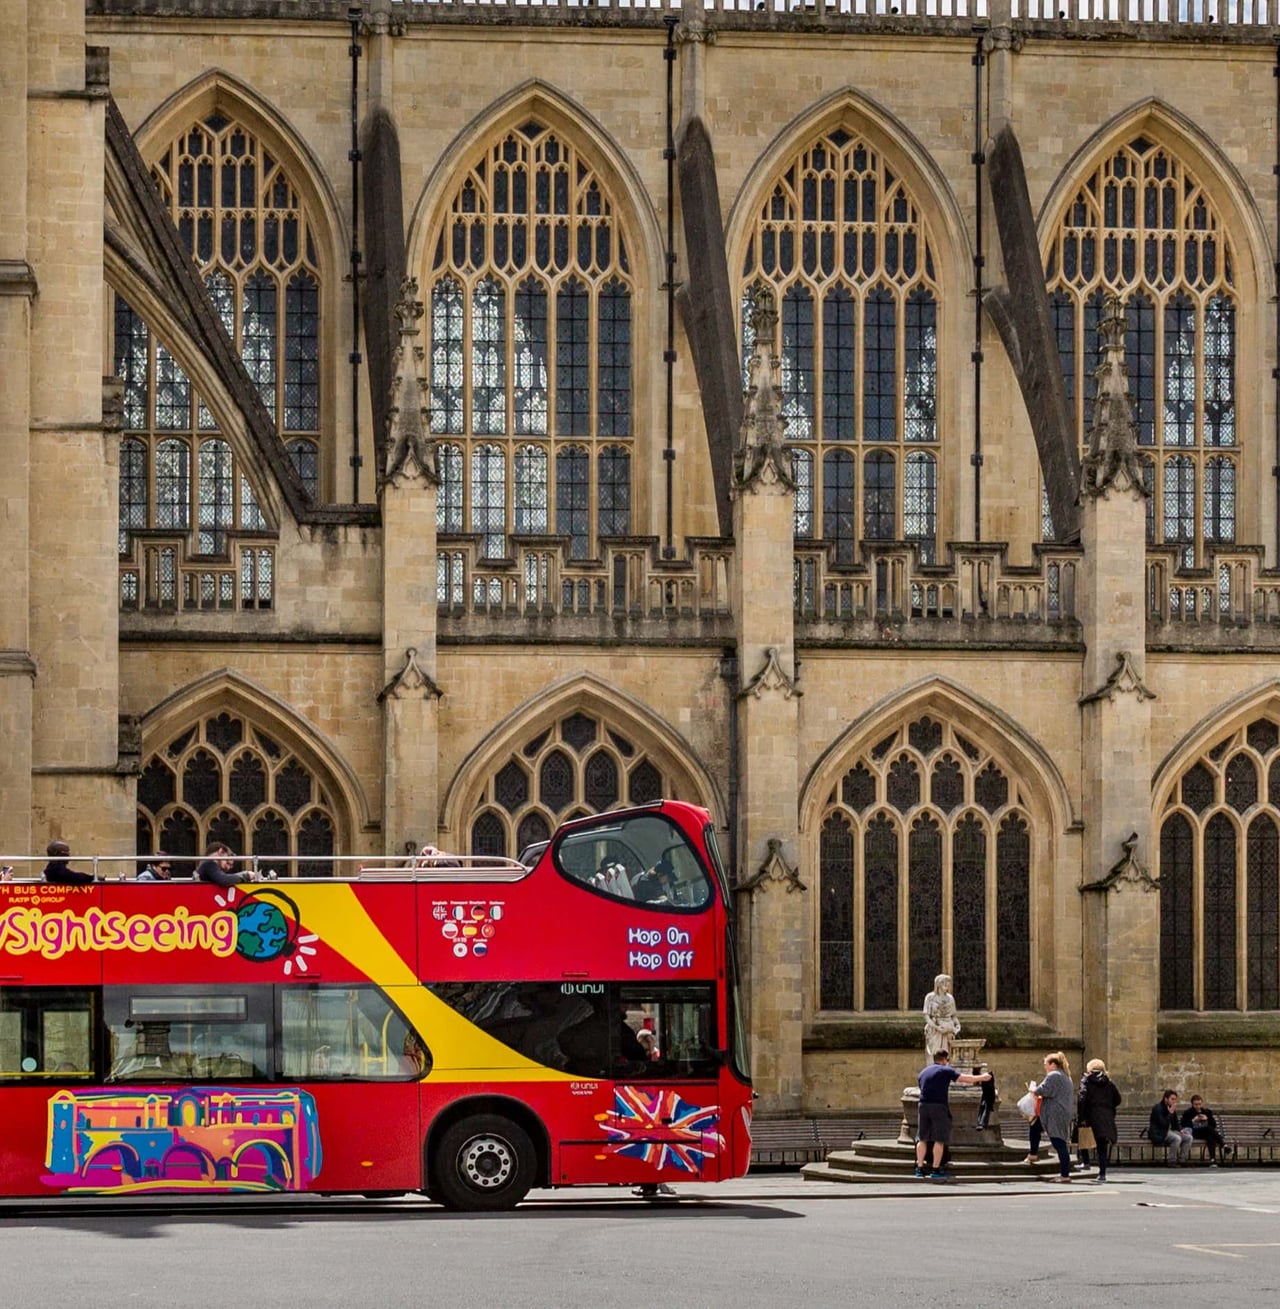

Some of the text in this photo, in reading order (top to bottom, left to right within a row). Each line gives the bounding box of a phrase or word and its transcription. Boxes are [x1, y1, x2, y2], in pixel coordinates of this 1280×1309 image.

[14, 886, 37, 894] BUS
[40, 886, 95, 894] COMPANY
[628, 927, 689, 946] Hop On
[629, 950, 693, 970] Hop Off
